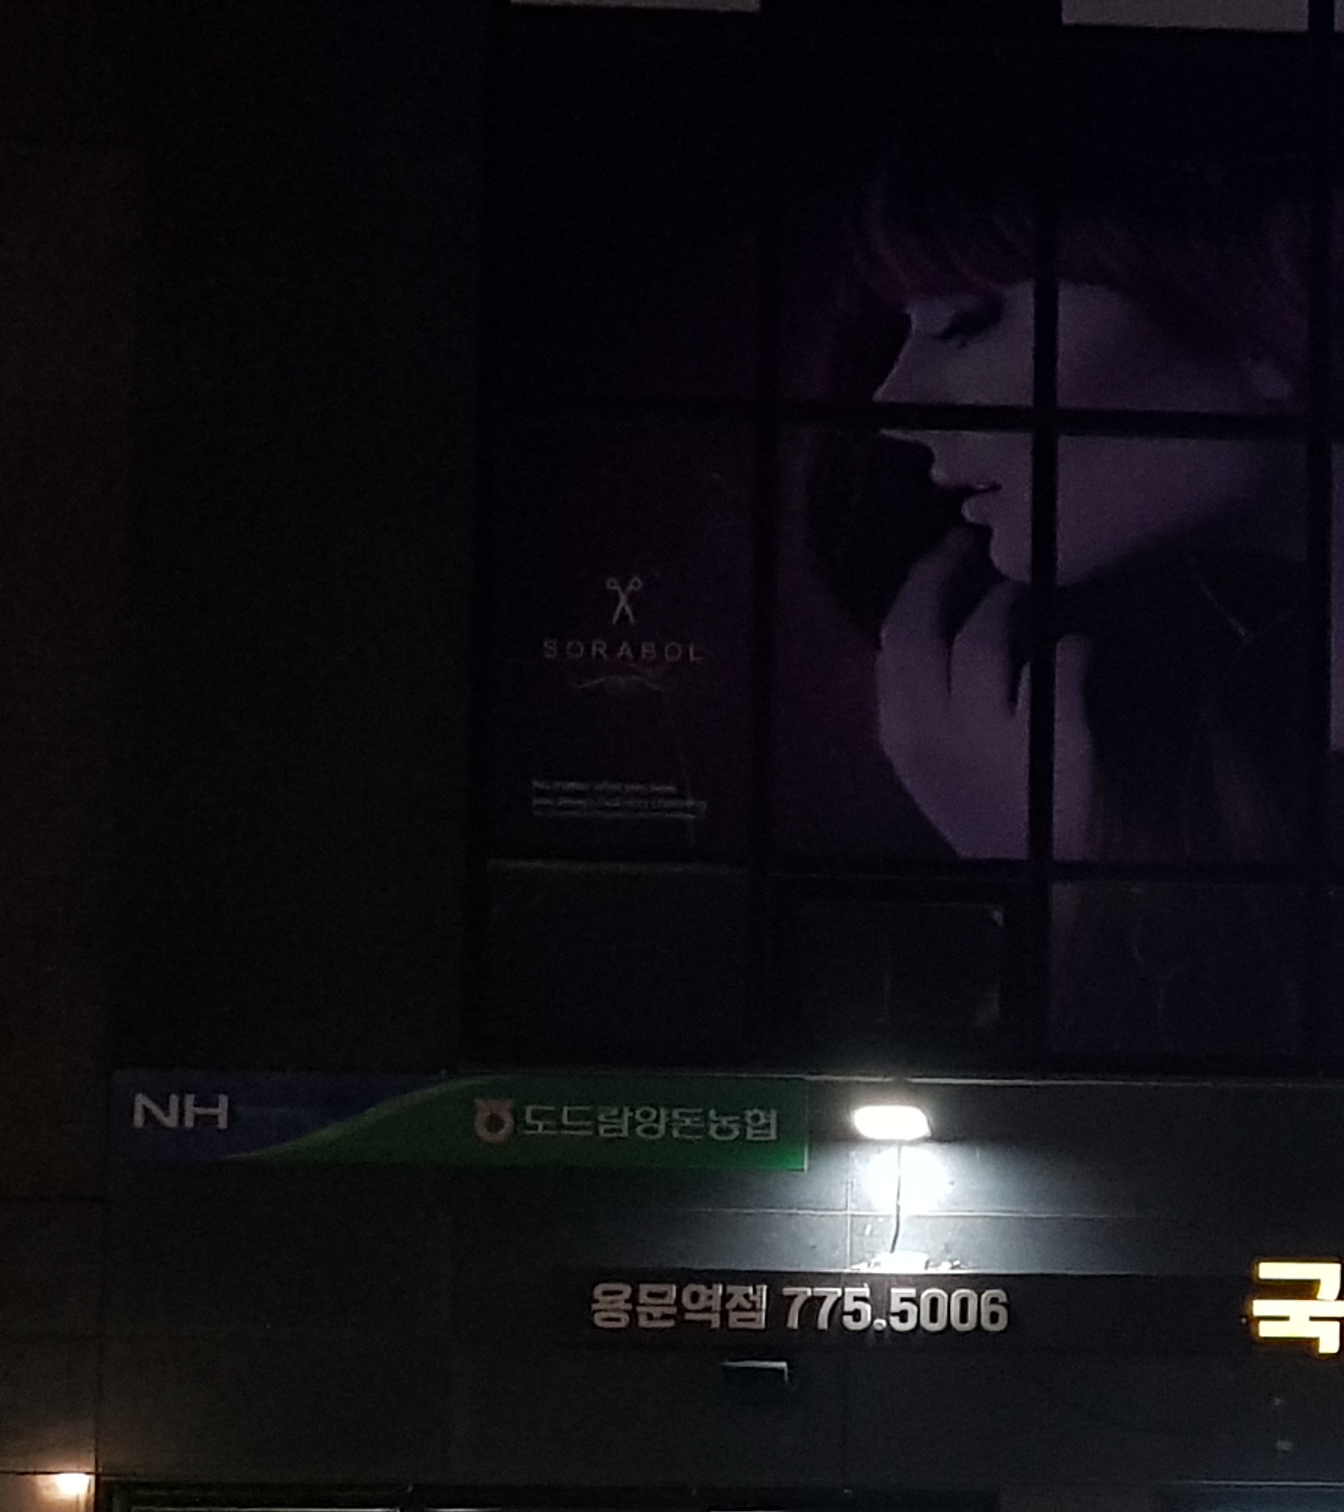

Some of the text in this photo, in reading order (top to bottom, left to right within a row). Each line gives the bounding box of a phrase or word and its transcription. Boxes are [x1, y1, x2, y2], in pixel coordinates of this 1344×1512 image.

[542, 636, 704, 663] SORABOL
[132, 1092, 231, 1131] NH
[521, 1103, 780, 1142] 도드람양돈농협
[590, 1281, 1010, 1333] 용문역점 775.5006
